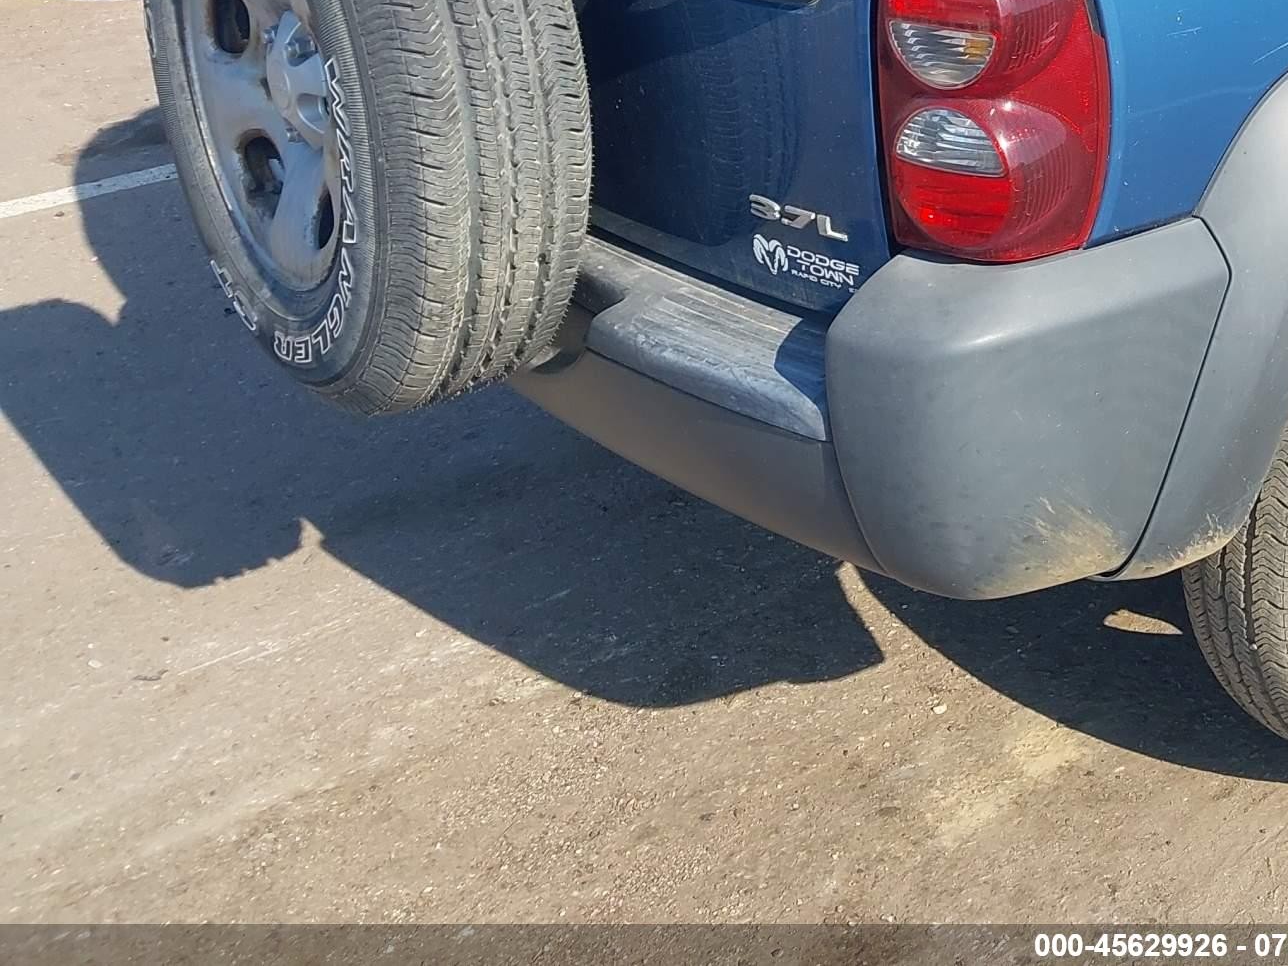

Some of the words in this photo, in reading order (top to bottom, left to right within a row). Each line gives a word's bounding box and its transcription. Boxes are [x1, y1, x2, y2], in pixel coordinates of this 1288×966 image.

[274, 57, 358, 364] WRANGLER
[749, 194, 849, 242] 3.7L
[786, 245, 860, 276] DODGE
[796, 259, 854, 286] TOWN
[820, 278, 842, 289] CITY
